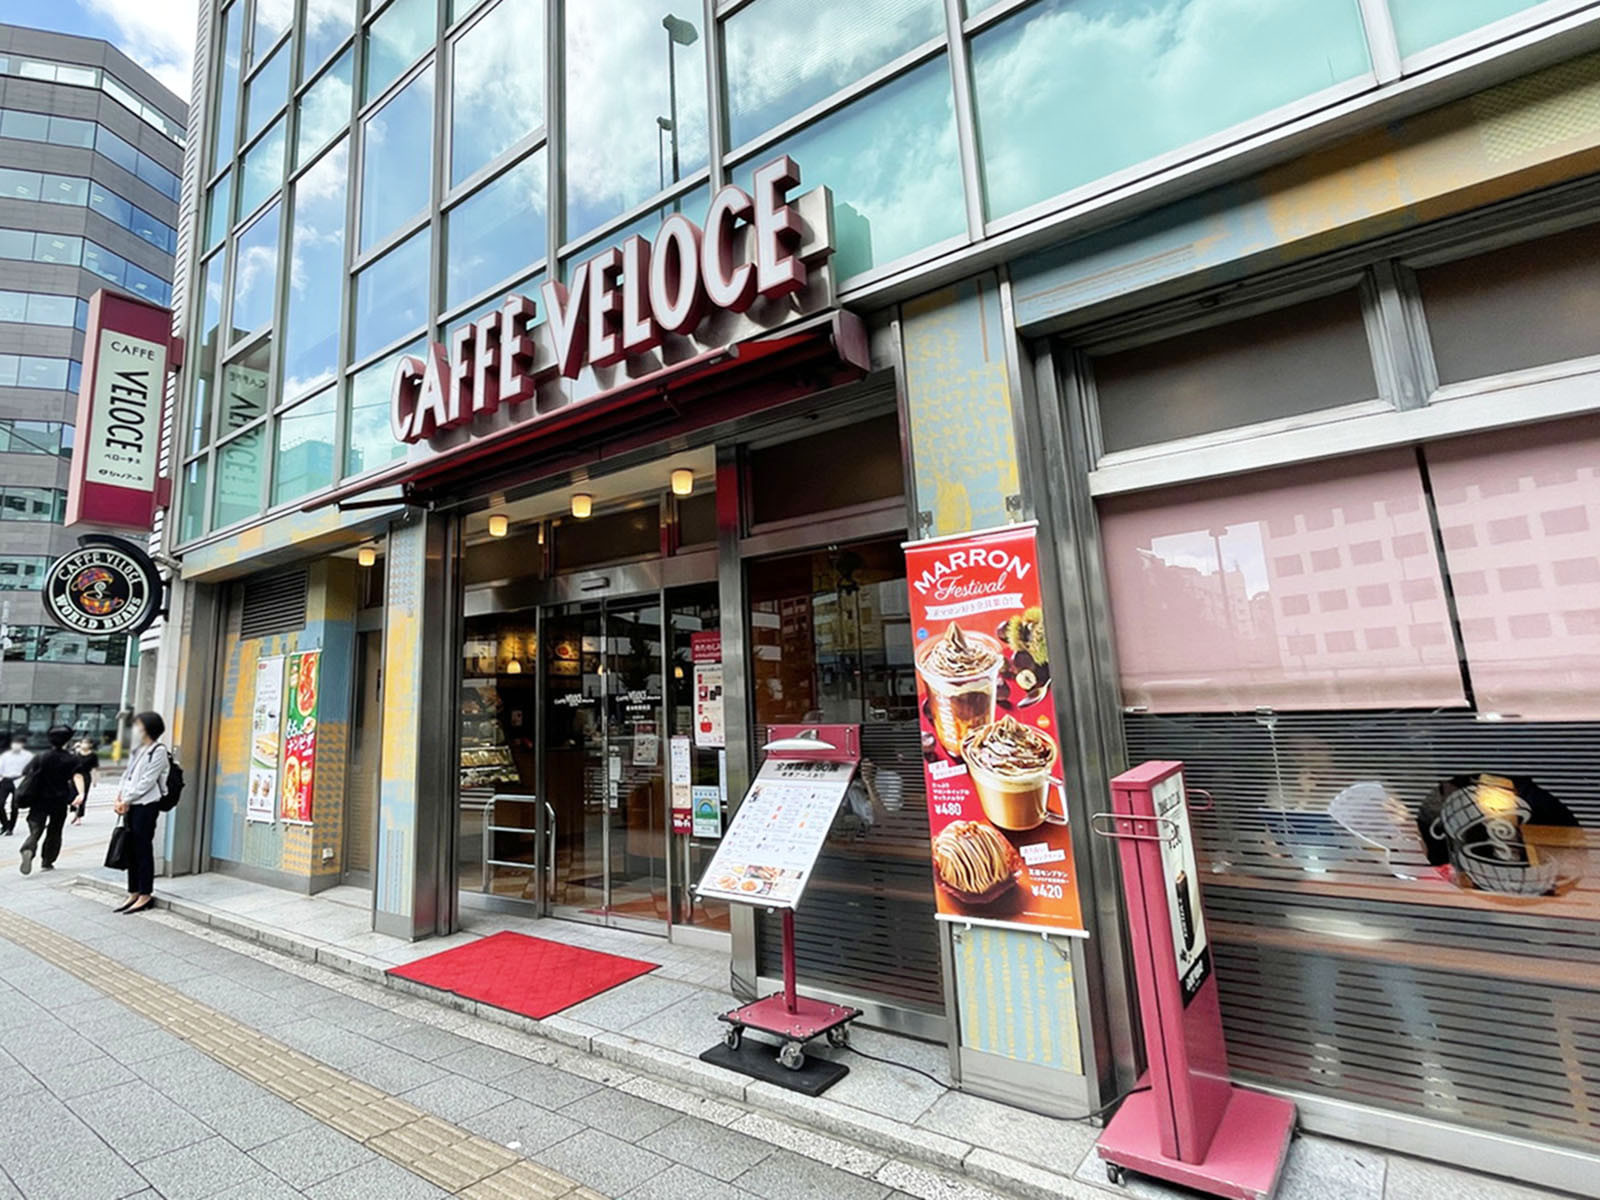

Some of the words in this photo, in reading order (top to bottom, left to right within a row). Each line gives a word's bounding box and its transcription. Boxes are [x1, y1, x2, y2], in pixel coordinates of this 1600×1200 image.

[541, 155, 807, 380] VELOCE
[106, 371, 149, 453] VELOCE
[913, 548, 1031, 595] MARRON
[934, 571, 1009, 601] Festival
[55, 594, 98, 629] WORLD
[103, 597, 142, 629] BEANS
[934, 802, 962, 816] ¥480
[1031, 884, 1063, 900] ¥420
